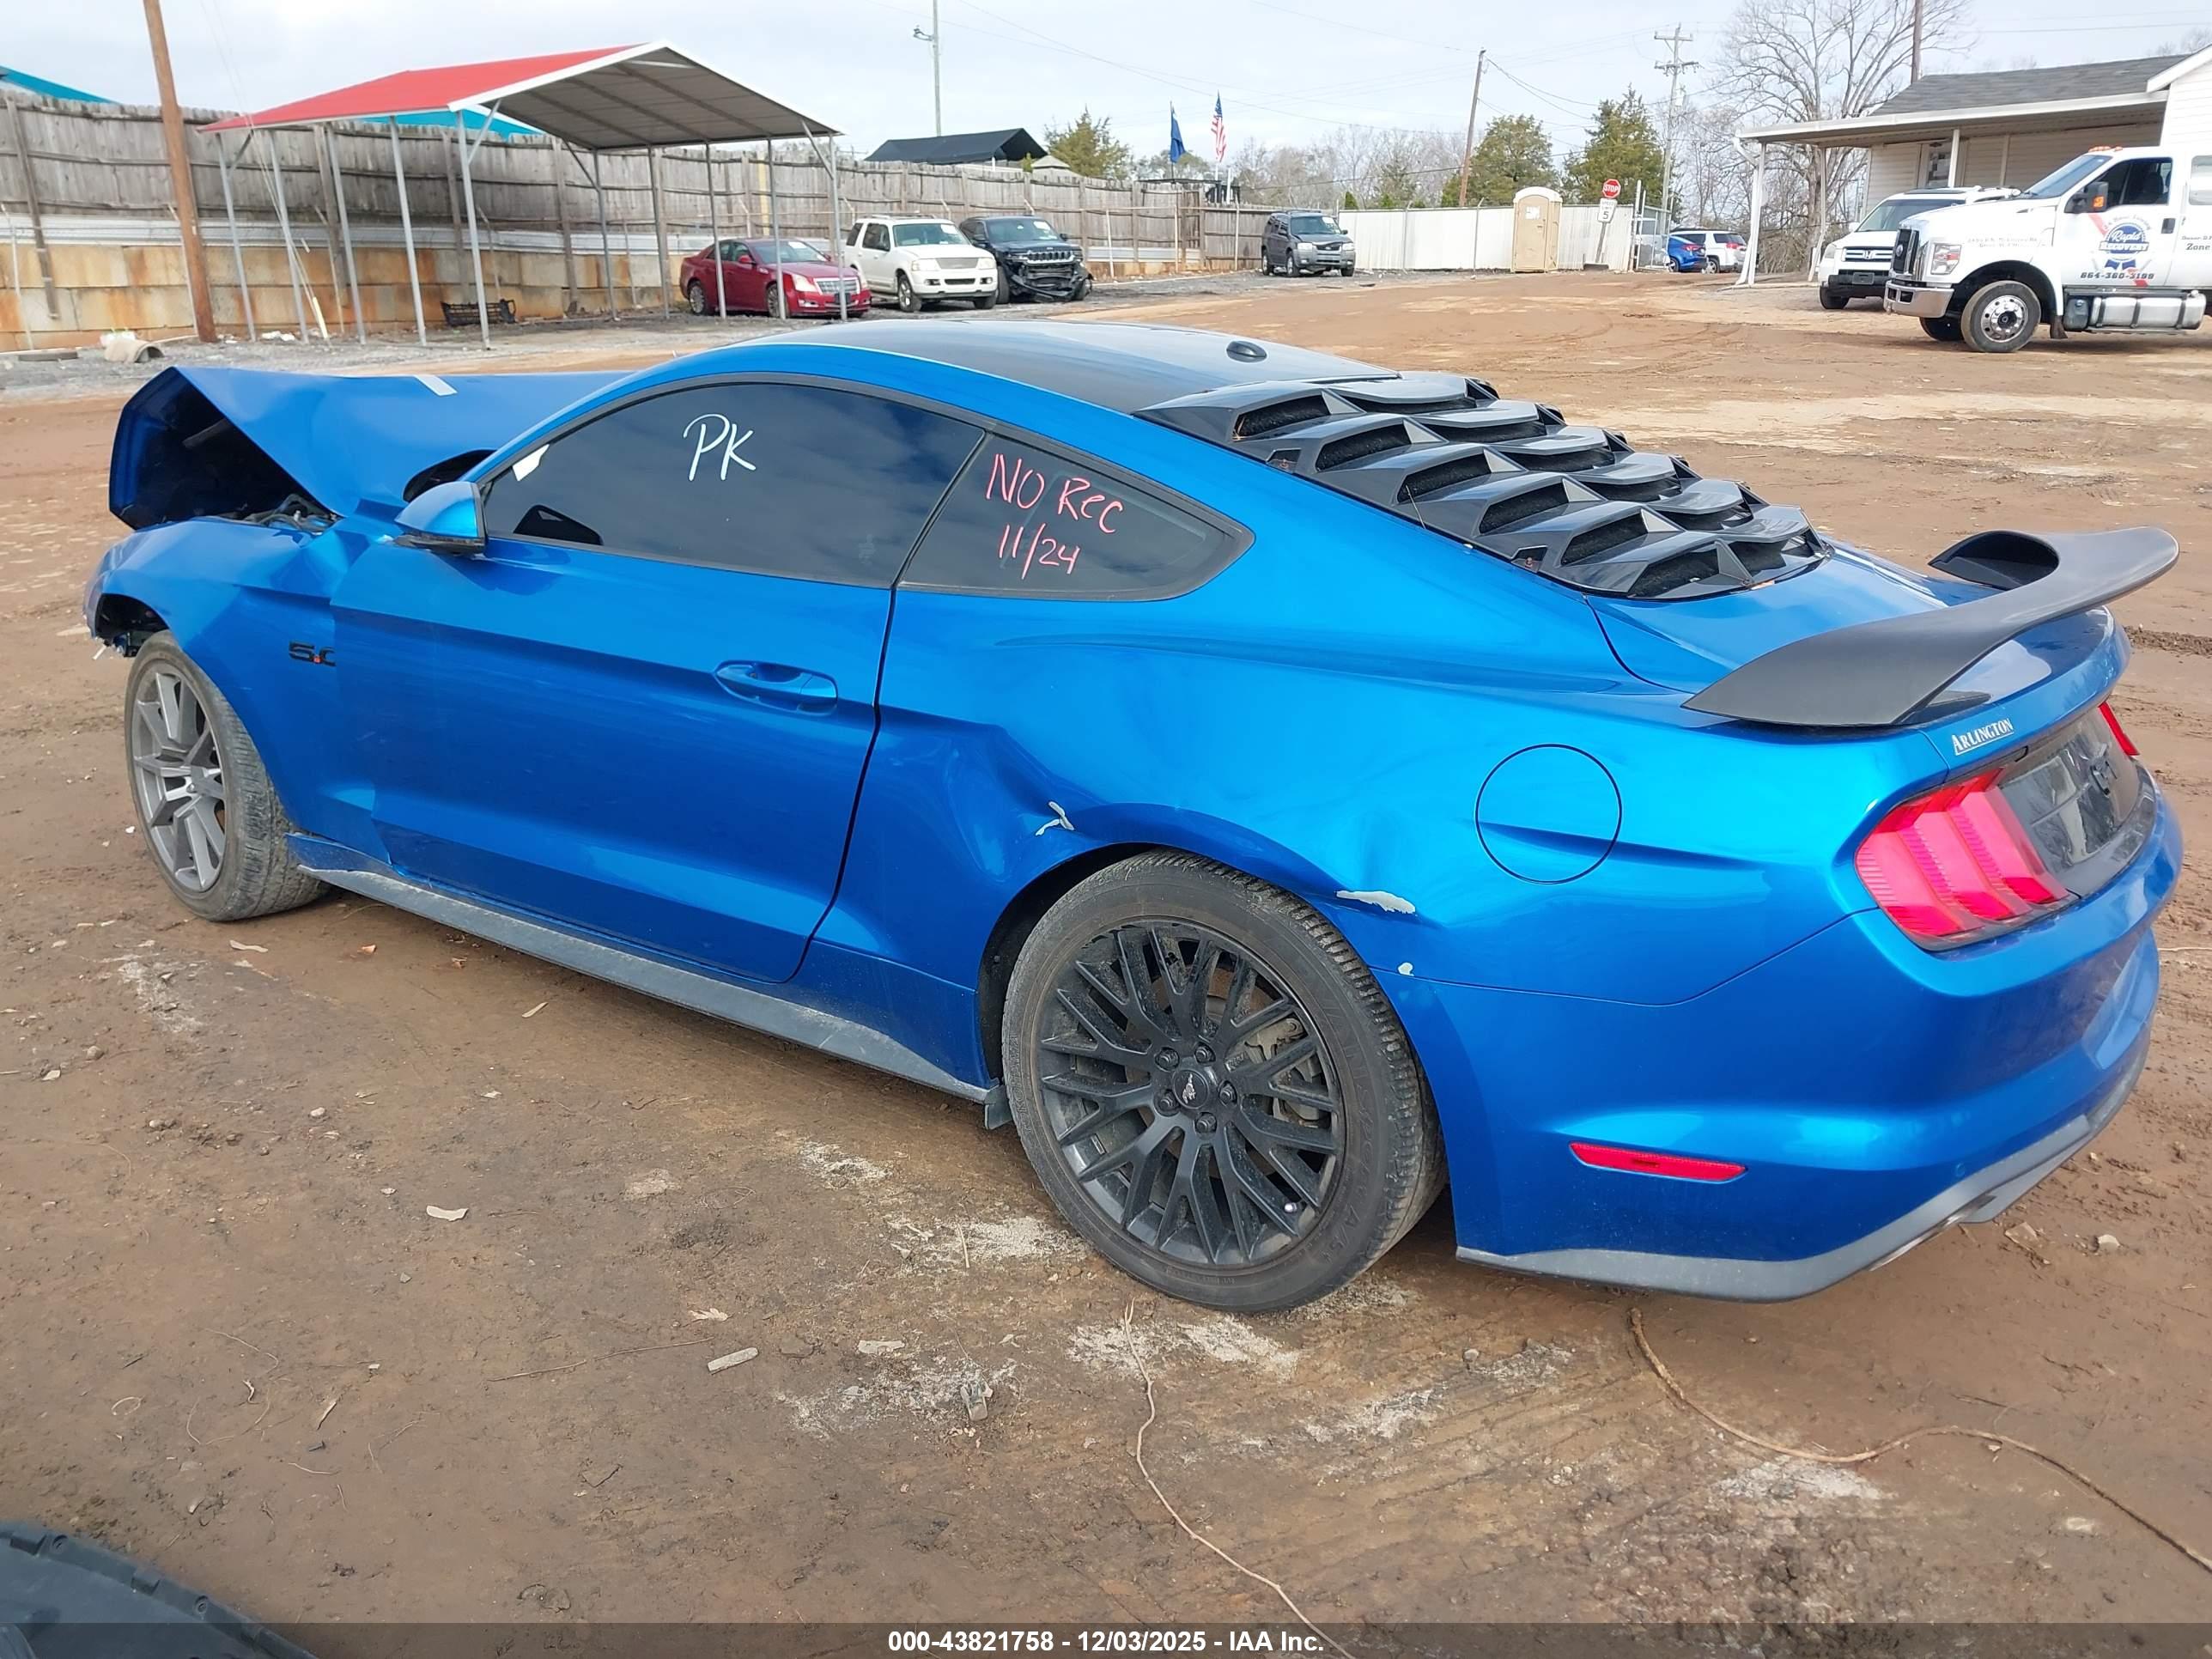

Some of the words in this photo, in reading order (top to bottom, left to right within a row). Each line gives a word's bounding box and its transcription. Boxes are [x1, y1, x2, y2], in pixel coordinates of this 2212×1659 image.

[1604, 184, 1619, 193] STOP
[1602, 210, 1609, 220] 5
[2111, 229, 2142, 243] Rapid
[683, 413, 757, 481] PK
[987, 453, 1045, 508] NO
[999, 523, 1081, 580] 11/24
[1952, 718, 2014, 753] ARLINGTON
